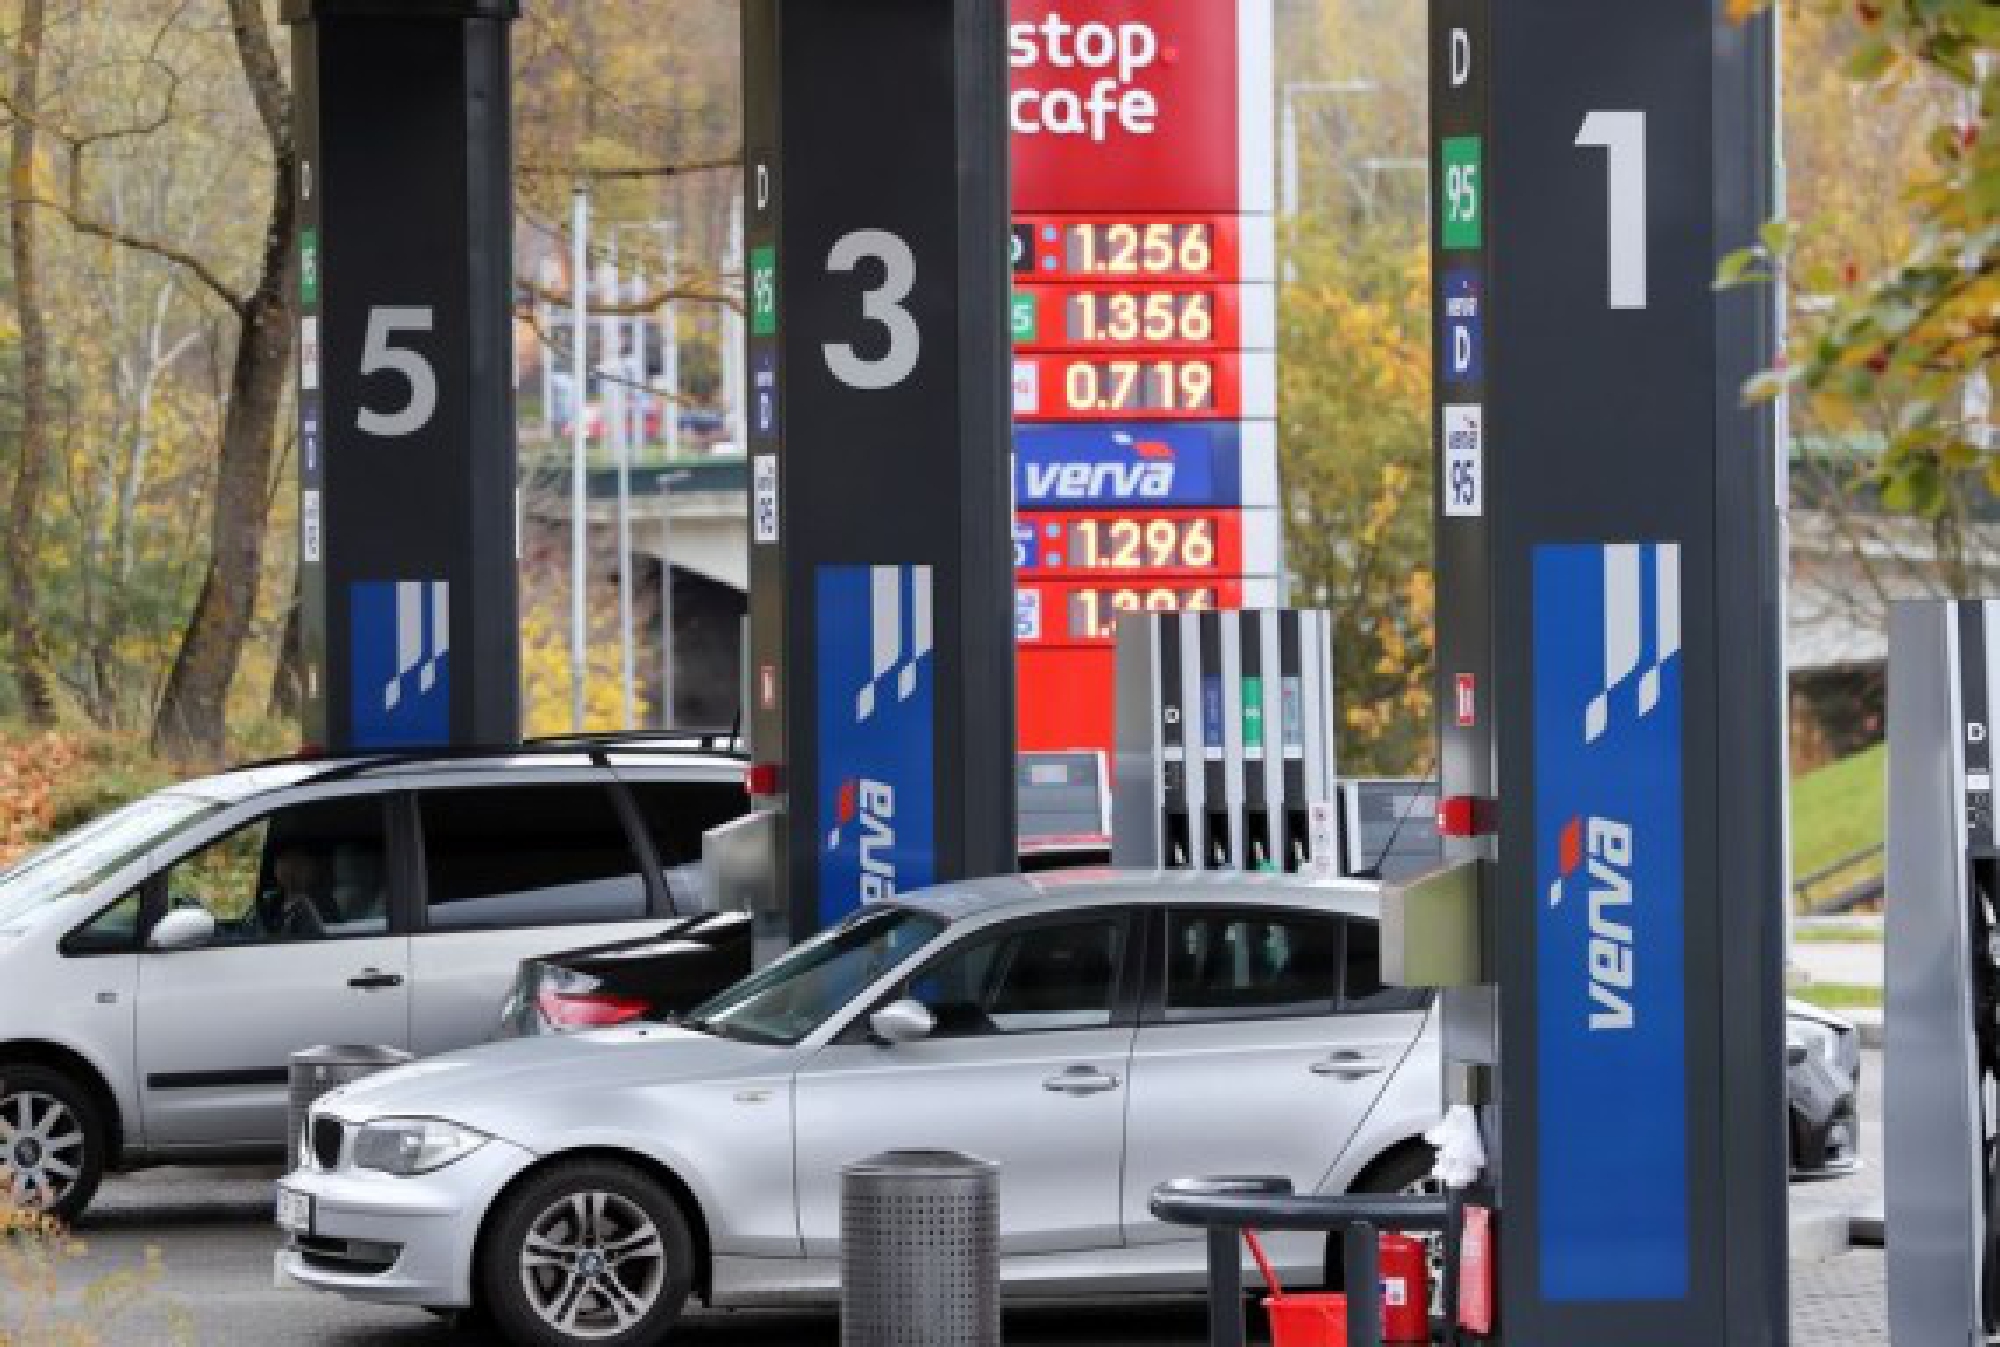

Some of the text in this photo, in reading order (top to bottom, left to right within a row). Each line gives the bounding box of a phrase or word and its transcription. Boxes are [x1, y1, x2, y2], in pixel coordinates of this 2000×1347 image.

[1009, 11, 1157, 83] stop
[1450, 28, 1470, 86] D
[1009, 77, 1158, 143] cafe
[1446, 165, 1477, 221] 95
[1572, 110, 1646, 309] 1
[1074, 223, 1211, 271] 1.256
[822, 228, 920, 389] 3
[1074, 292, 1211, 341] 1.356
[355, 305, 438, 436] 5
[1454, 325, 1471, 373] D
[1066, 360, 1211, 410] 0.719
[1025, 461, 1176, 499] verva
[1077, 518, 1214, 568] 1.296
[859, 778, 896, 905] erva
[1588, 816, 1633, 1031] verva
